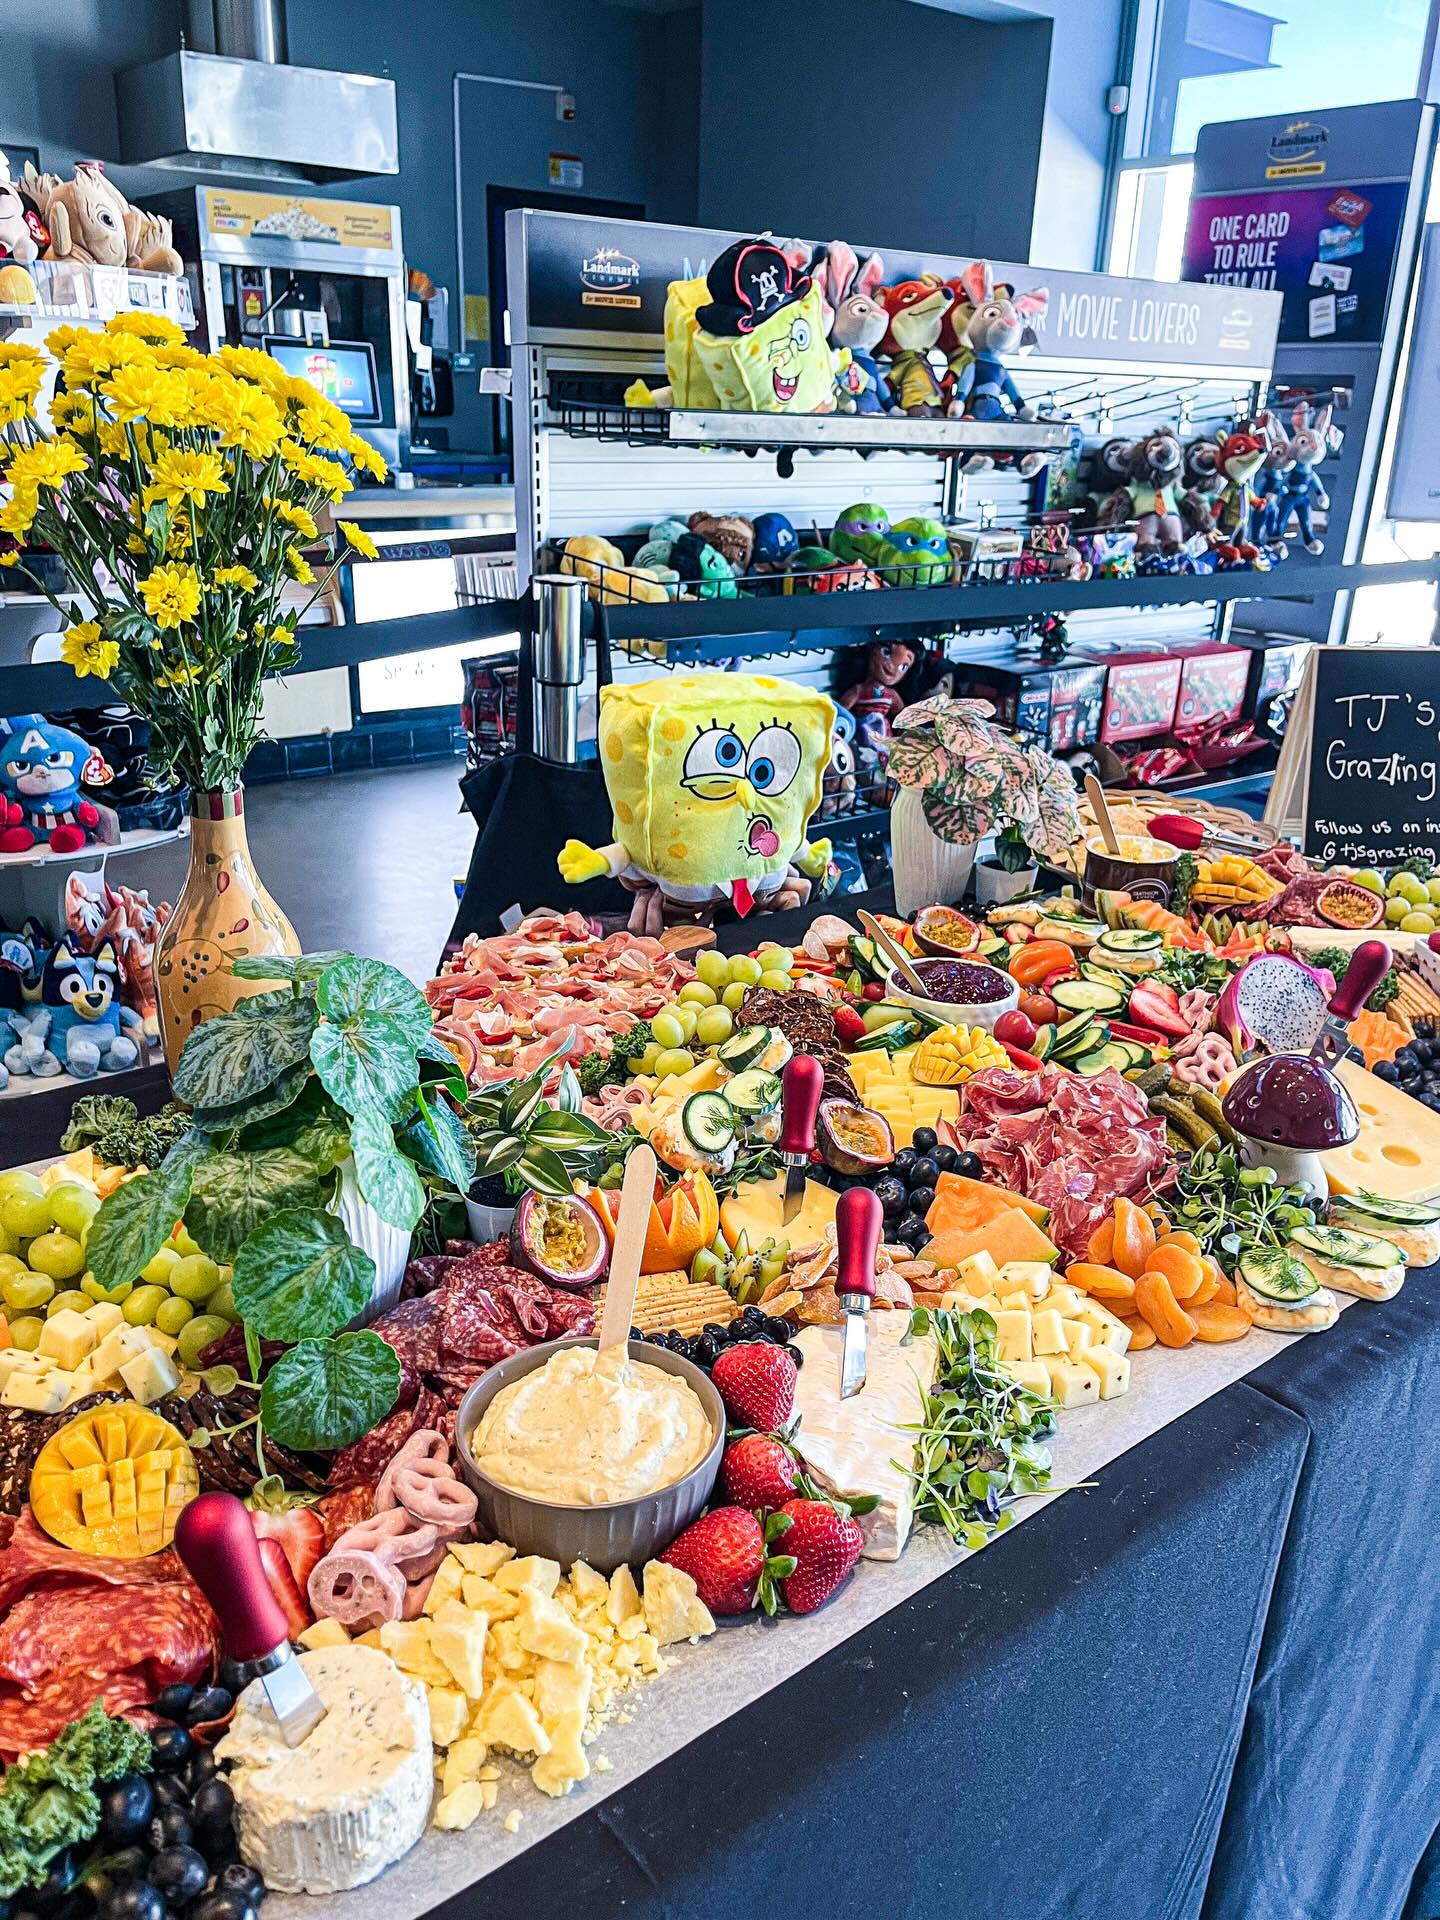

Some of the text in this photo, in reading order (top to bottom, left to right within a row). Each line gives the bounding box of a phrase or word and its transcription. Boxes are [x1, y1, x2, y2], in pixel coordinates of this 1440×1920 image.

[1209, 215, 1243, 242] ONE
[1245, 211, 1290, 240] CARD
[583, 259, 639, 276] Landmark
[1213, 241, 1279, 269] TO RULE
[1056, 292, 1122, 340] MOVIE
[1128, 299, 1200, 345] LOVERS
[1335, 693, 1435, 732] TJ's
[1326, 740, 1436, 801] Grazing
[1314, 819, 1363, 835] Follow
[1371, 820, 1392, 834] us
[1402, 822, 1421, 834] on
